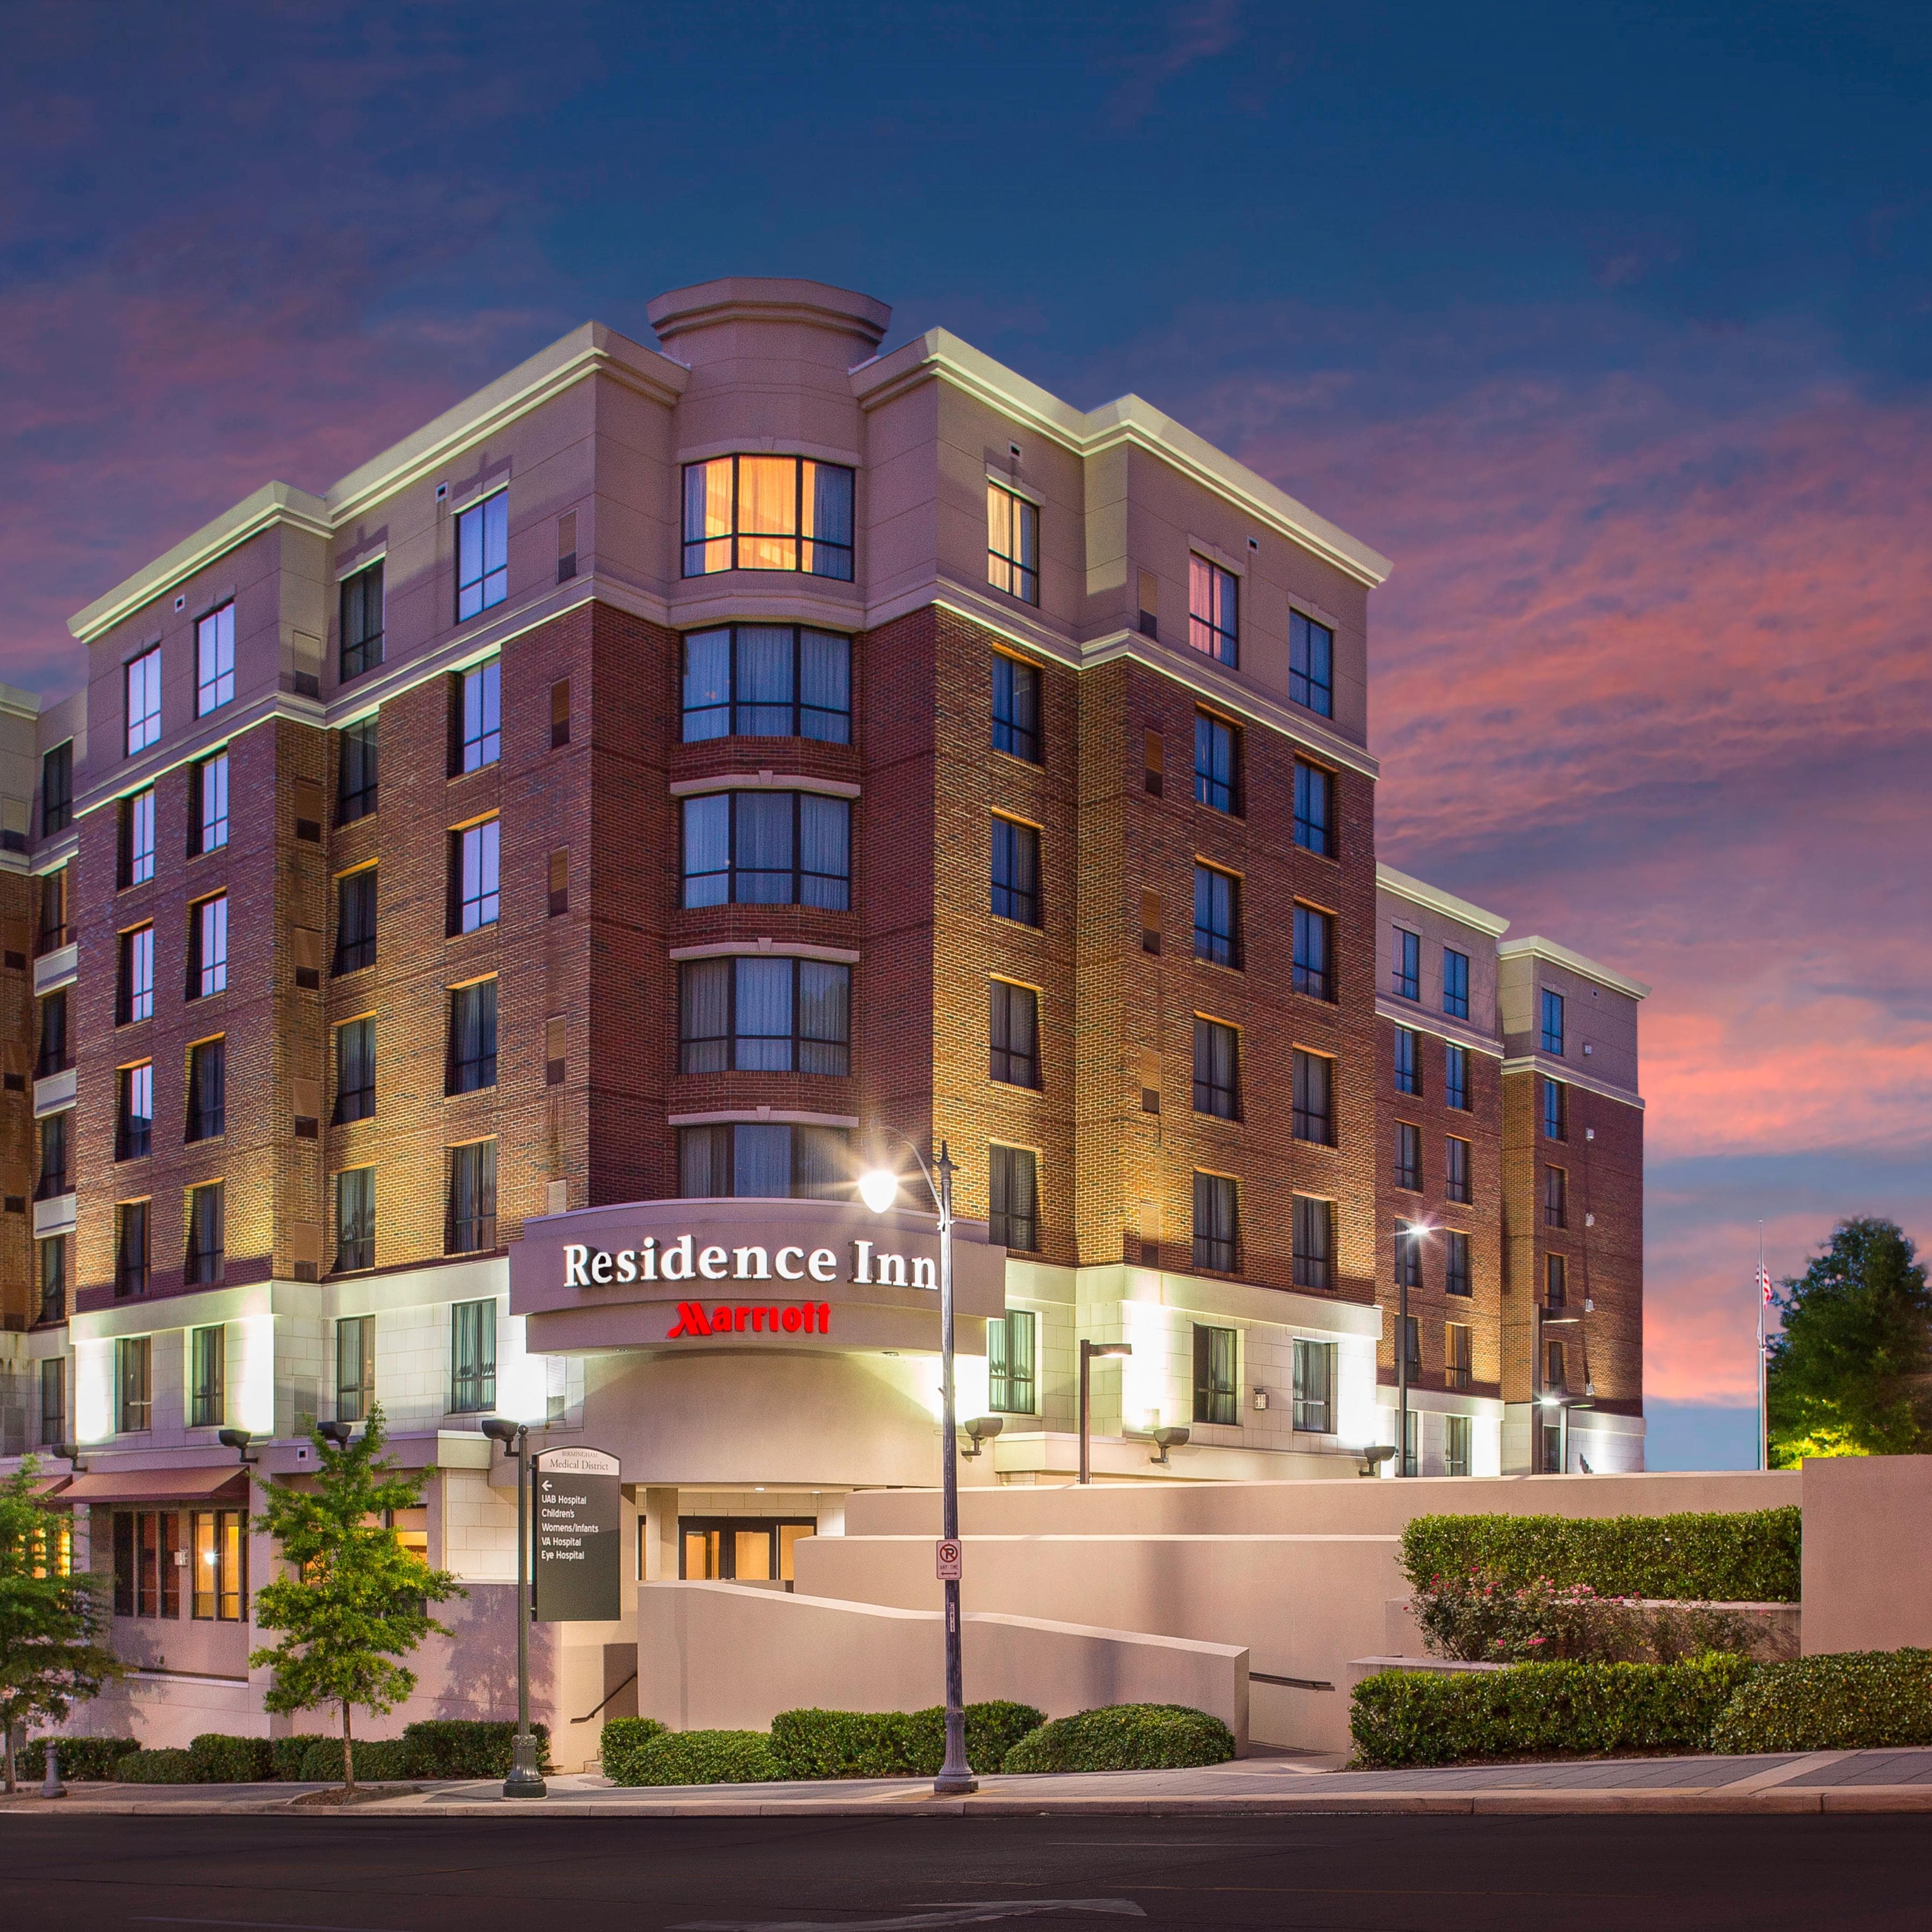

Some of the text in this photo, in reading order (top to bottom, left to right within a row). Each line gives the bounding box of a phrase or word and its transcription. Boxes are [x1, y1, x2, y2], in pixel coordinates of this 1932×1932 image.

[564, 1234, 939, 1290] Residence Inn
[667, 1301, 831, 1338] Marriott
[550, 1459, 608, 1470] Medical District
[541, 1495, 587, 1506] UAB Hospital
[541, 1509, 575, 1518] Children's
[541, 1523, 599, 1533] Womens/Infants
[541, 1537, 581, 1548] VA Hospital
[541, 1550, 584, 1561] Eye Hospital
